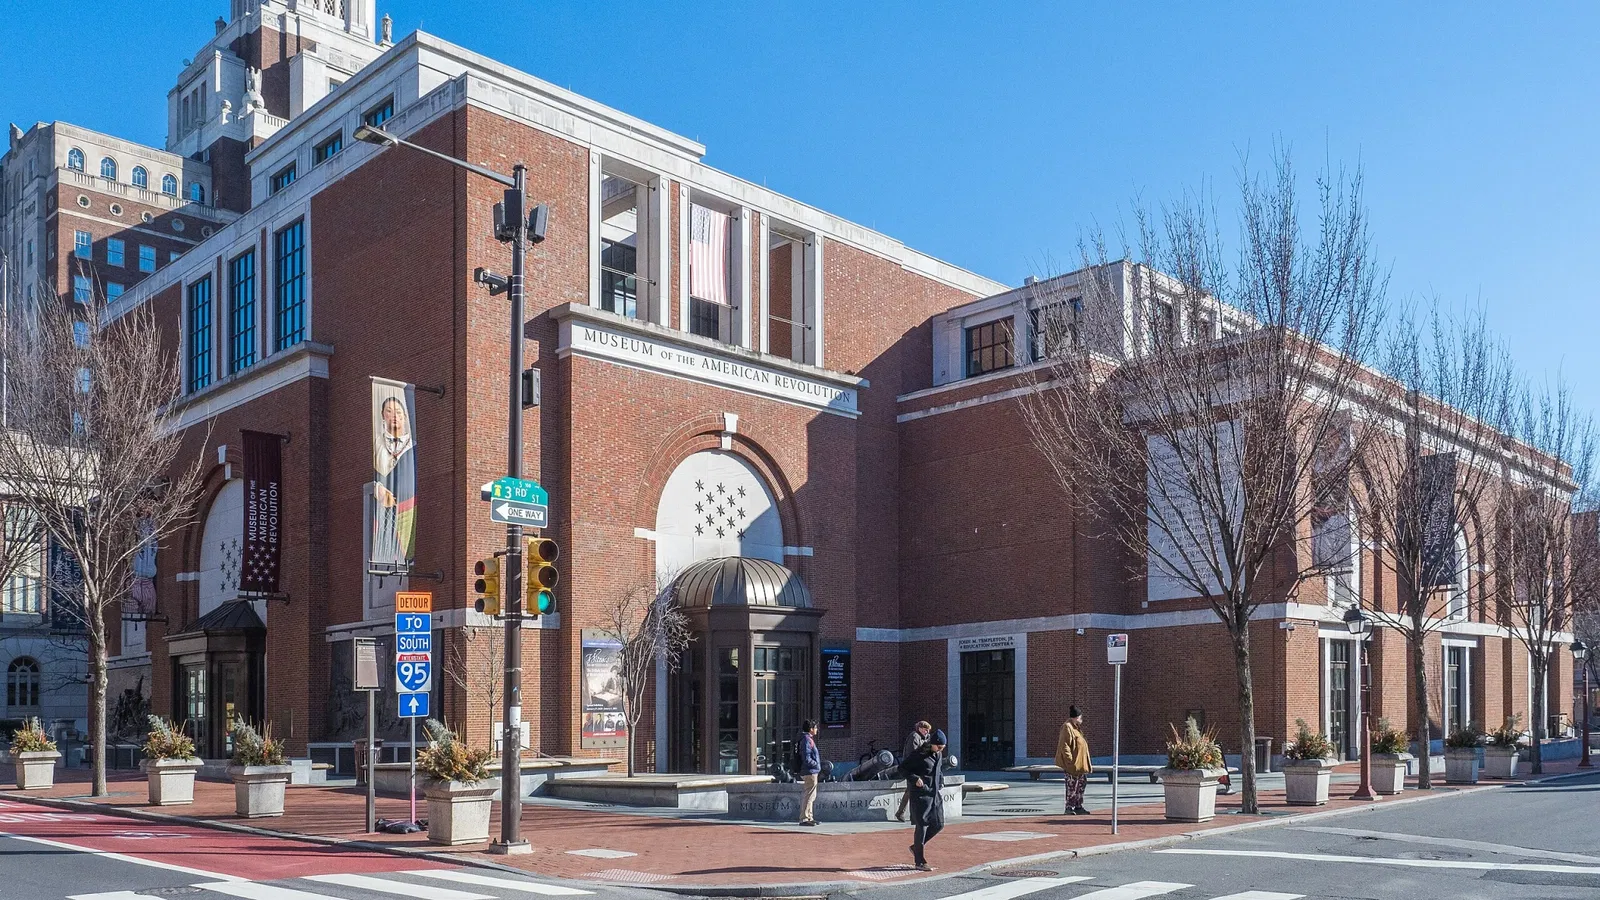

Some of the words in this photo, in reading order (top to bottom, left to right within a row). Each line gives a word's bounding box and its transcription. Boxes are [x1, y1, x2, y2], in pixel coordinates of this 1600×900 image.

[585, 328, 653, 356] MUSEUM
[660, 350, 673, 361] OF
[676, 353, 695, 367] THE
[701, 357, 770, 383] AMERICAN
[774, 374, 850, 403] REVOLUTION
[250, 492, 256, 500] OF
[504, 486, 512, 499] 3
[531, 493, 540, 504] ST
[270, 482, 278, 544] REVOLUTION
[508, 507, 524, 518] ONE
[525, 510, 542, 520] WAY
[249, 501, 257, 541] MUSEUM
[400, 597, 429, 609] DETOUR
[405, 617, 423, 629] TO
[399, 637, 429, 650] SOUTH
[400, 662, 427, 684] 95
[740, 802, 790, 811] MUSEUM
[832, 798, 890, 810] AMERICAN
